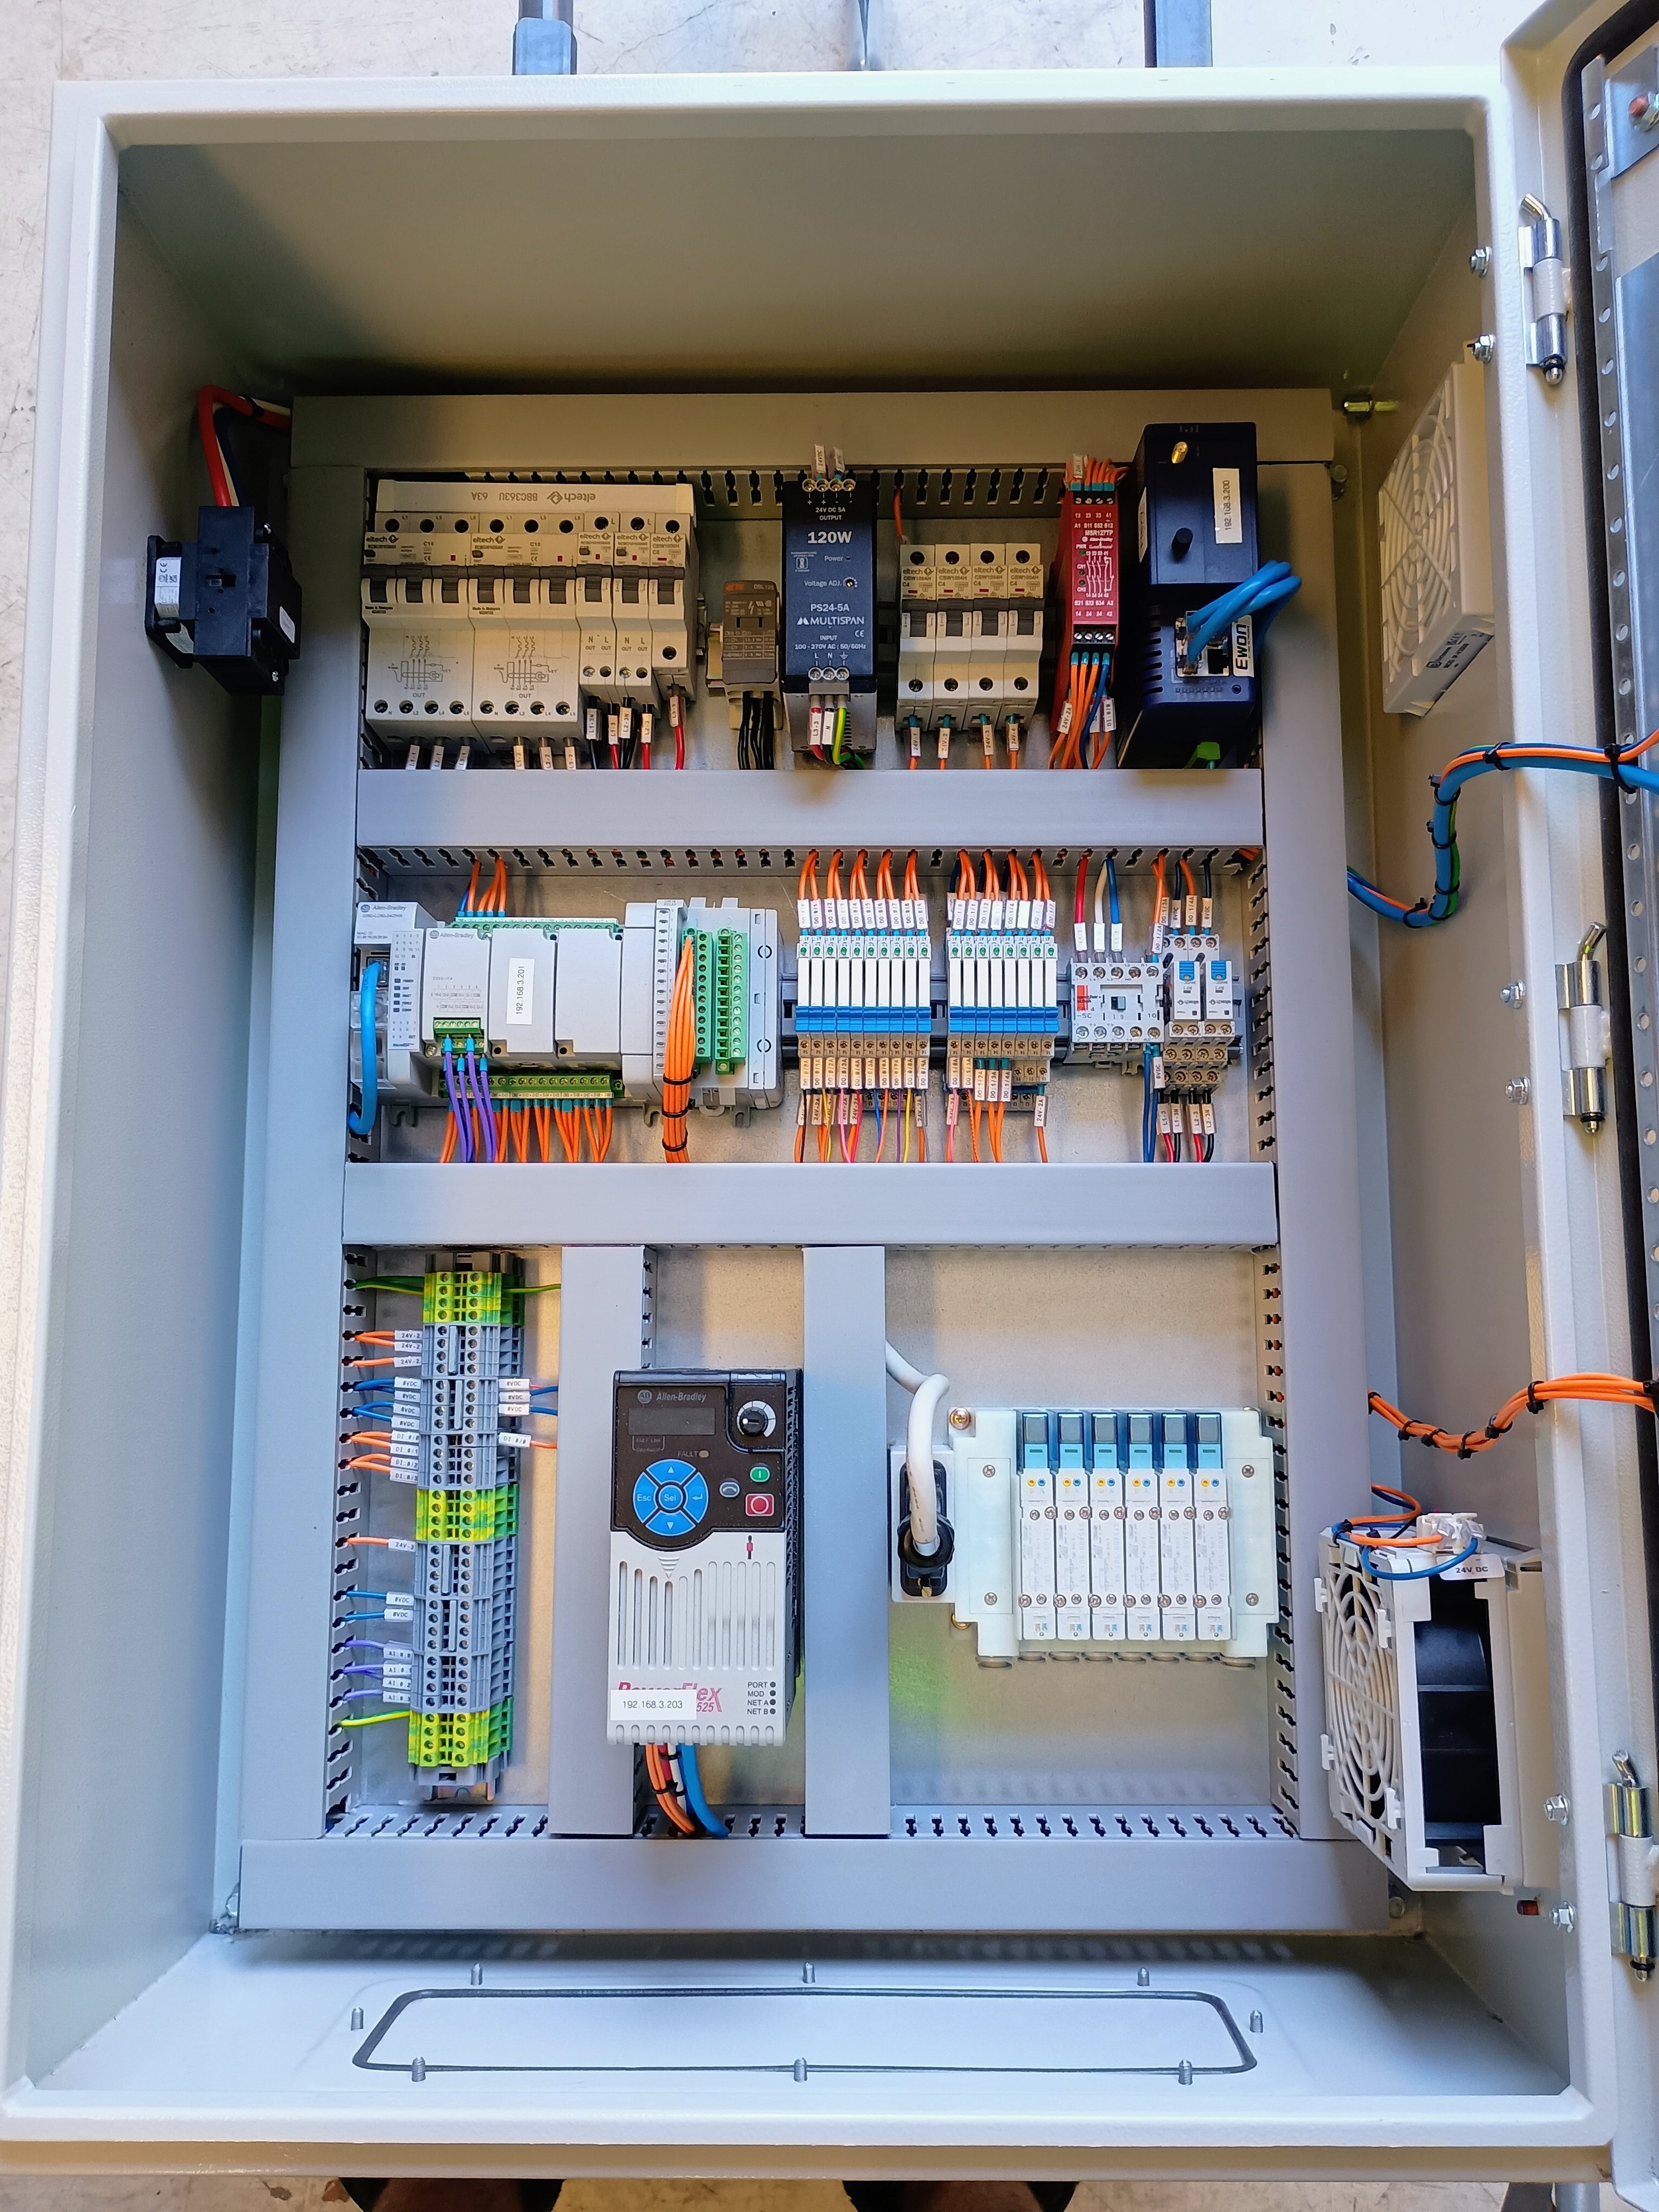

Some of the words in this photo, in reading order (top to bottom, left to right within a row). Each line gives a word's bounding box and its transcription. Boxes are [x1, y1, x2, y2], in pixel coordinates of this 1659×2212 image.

[471, 492, 488, 500] 63A
[499, 492, 538, 501] BBC363U
[565, 493, 596, 502] eltech
[808, 531, 852, 544] 120W
[516, 966, 524, 1014] 192.168.3.201
[656, 1392, 706, 1402] Allen-Bradley
[623, 1700, 683, 1709] 192.168.3.203
[697, 1702, 714, 1712] 525
